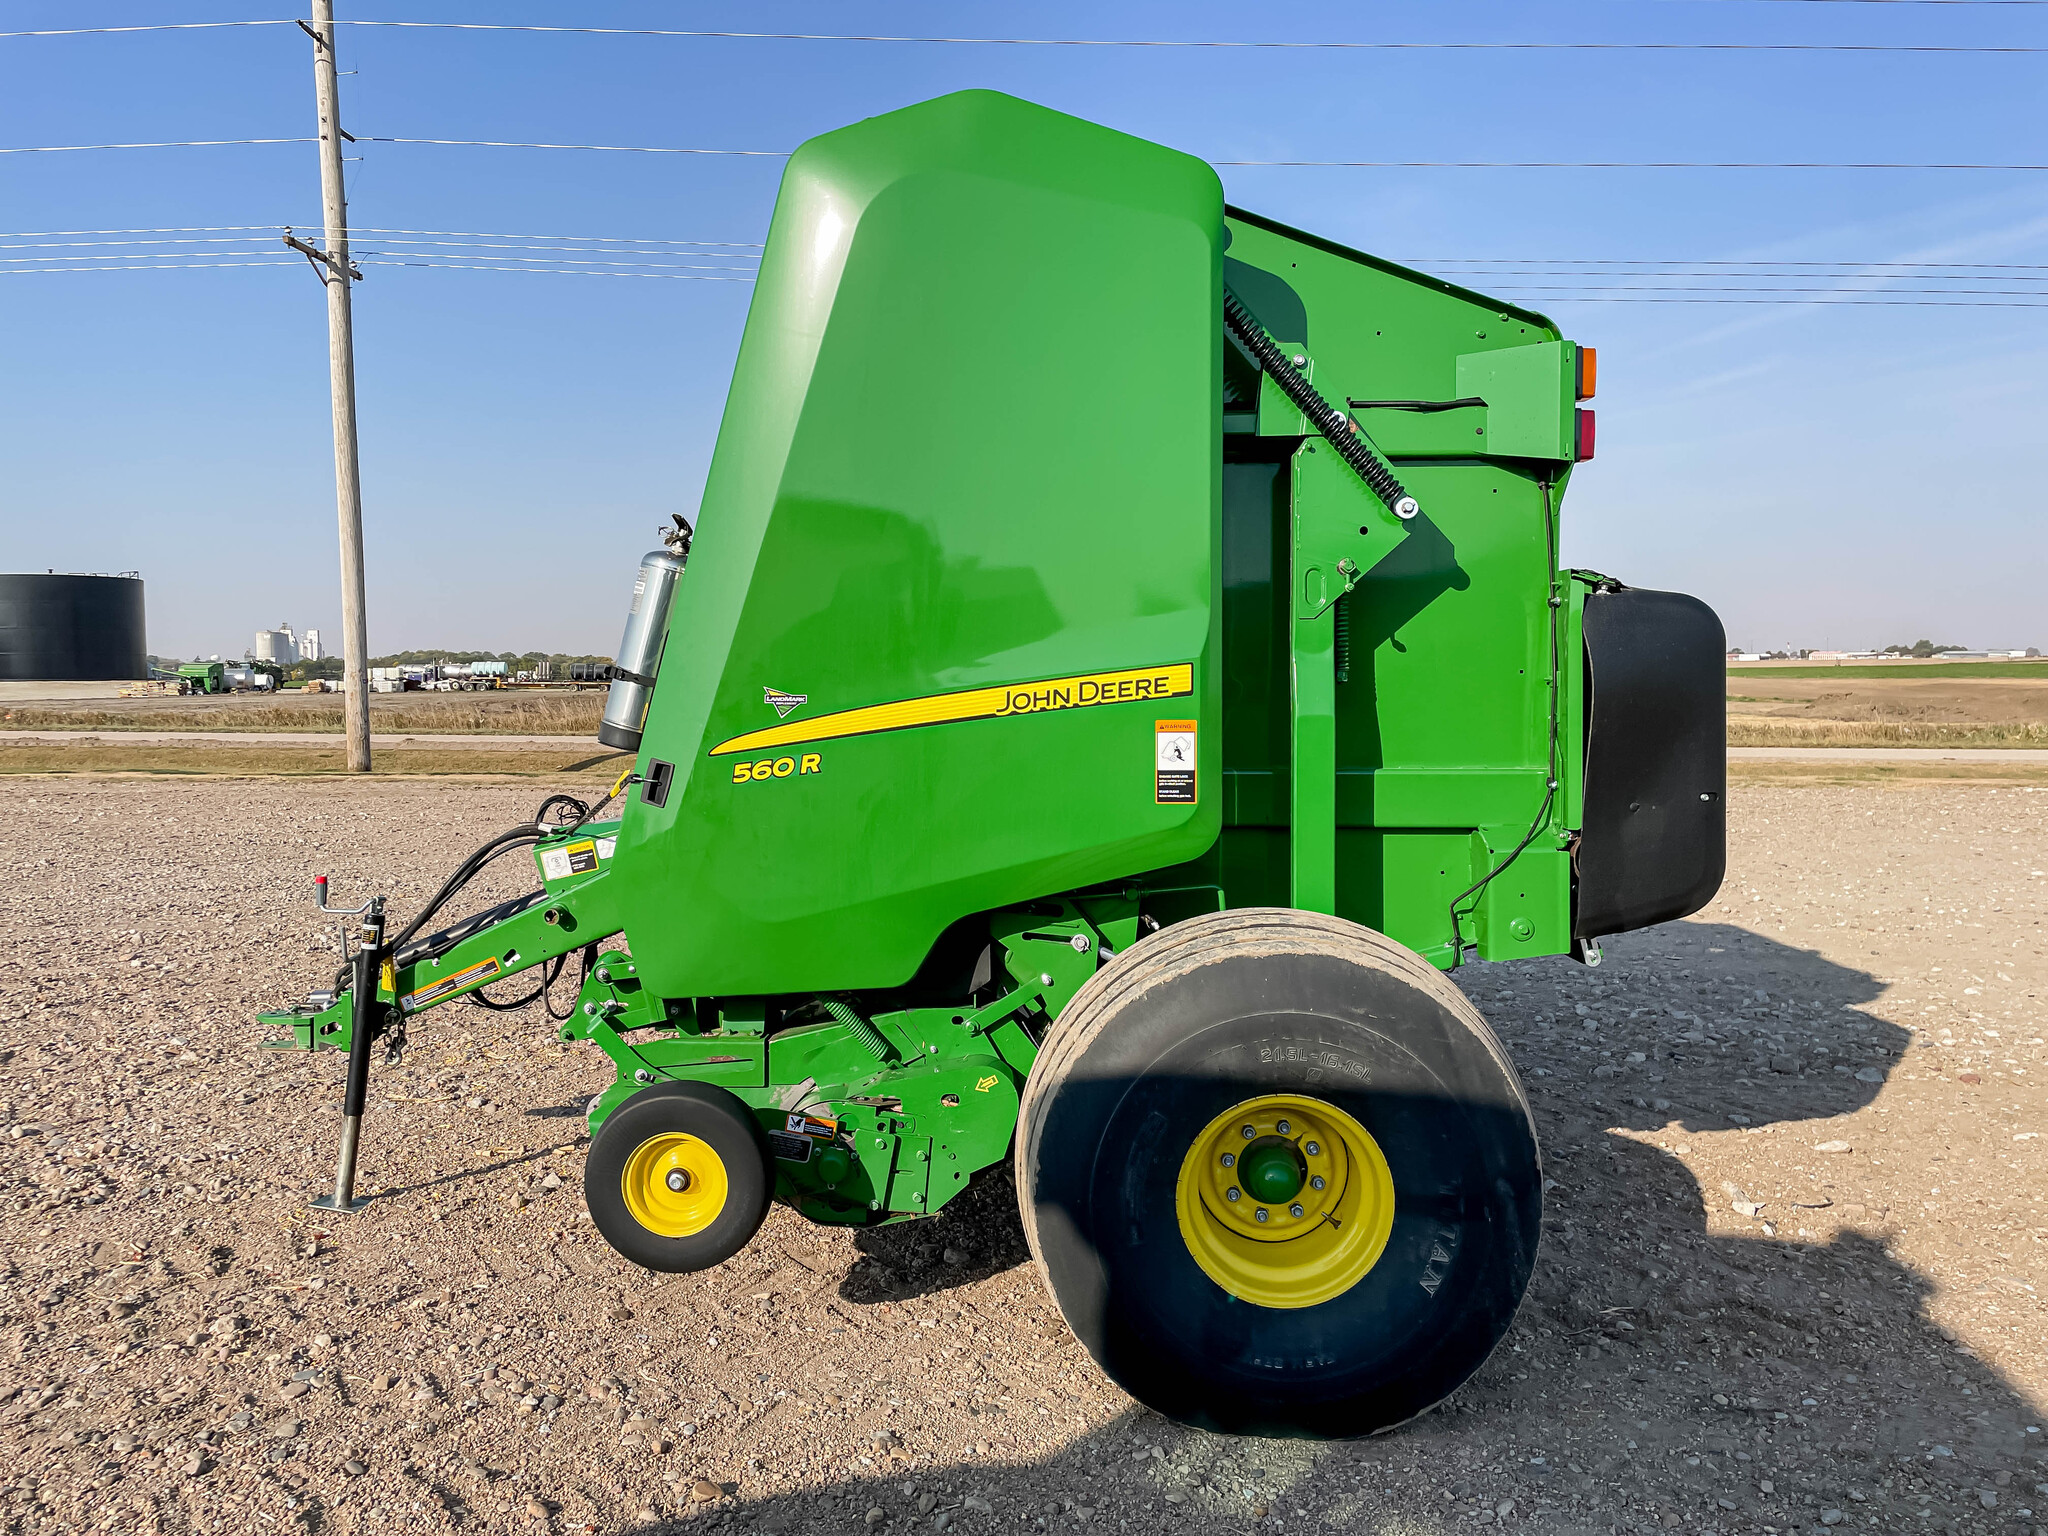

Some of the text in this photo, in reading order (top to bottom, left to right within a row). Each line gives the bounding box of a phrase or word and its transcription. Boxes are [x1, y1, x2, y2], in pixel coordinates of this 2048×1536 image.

[996, 676, 1170, 713] JOHN DEERE
[732, 752, 822, 784] 560 R
